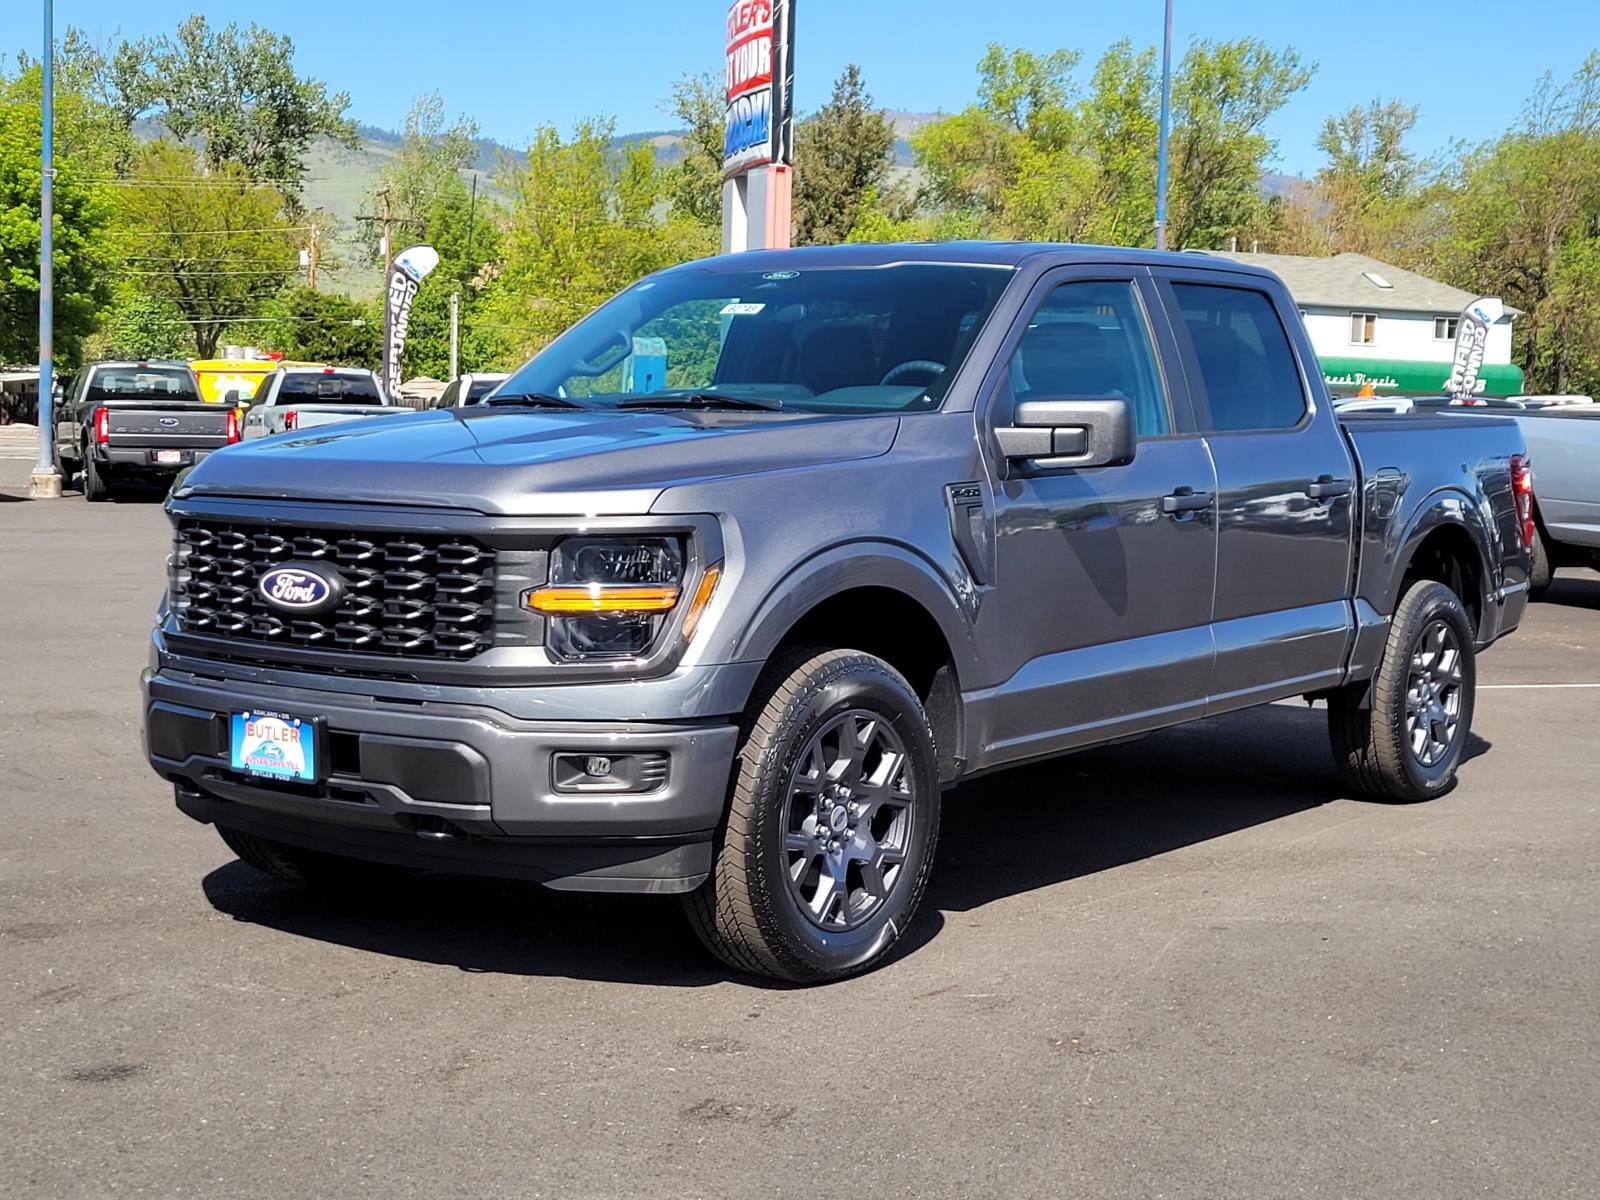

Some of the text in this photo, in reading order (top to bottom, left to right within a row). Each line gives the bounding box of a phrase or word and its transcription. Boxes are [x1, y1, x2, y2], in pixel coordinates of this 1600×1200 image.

[735, 36, 771, 86] YOUR
[1323, 372, 1355, 385] reek
[272, 573, 316, 602] Ford
[247, 723, 299, 743] BUTLER
